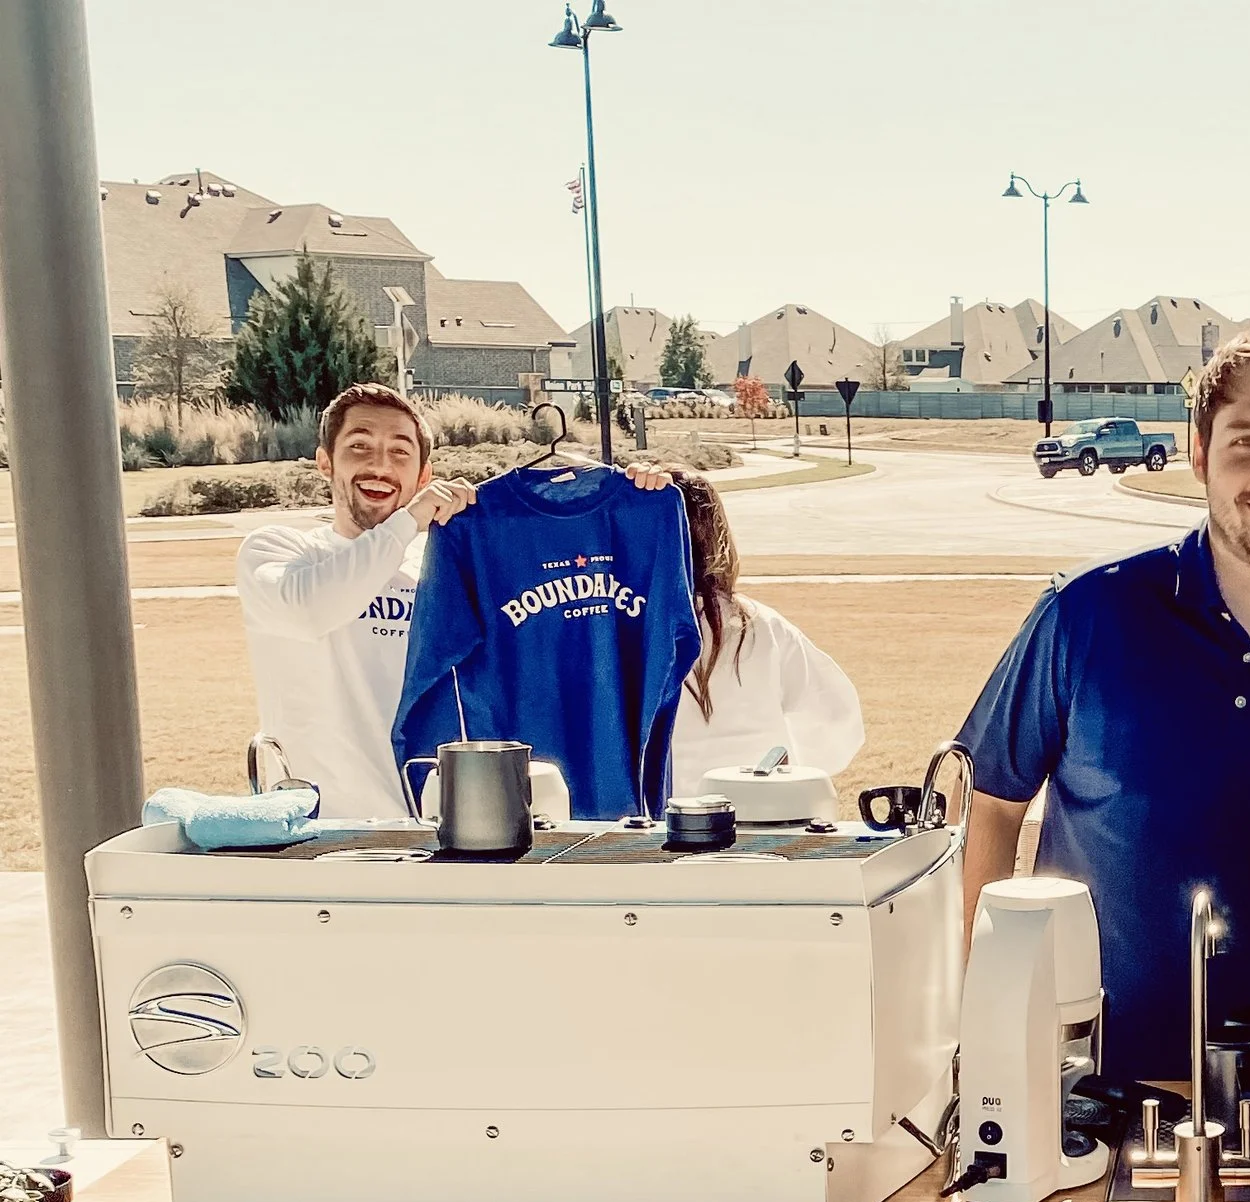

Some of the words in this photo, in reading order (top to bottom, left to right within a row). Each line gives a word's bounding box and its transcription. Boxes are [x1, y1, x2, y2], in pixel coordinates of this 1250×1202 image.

[542, 560, 571, 569] TEXAS
[564, 605, 608, 619] COFFEE
[372, 626, 405, 638] COFF
[252, 1045, 377, 1080] 200
